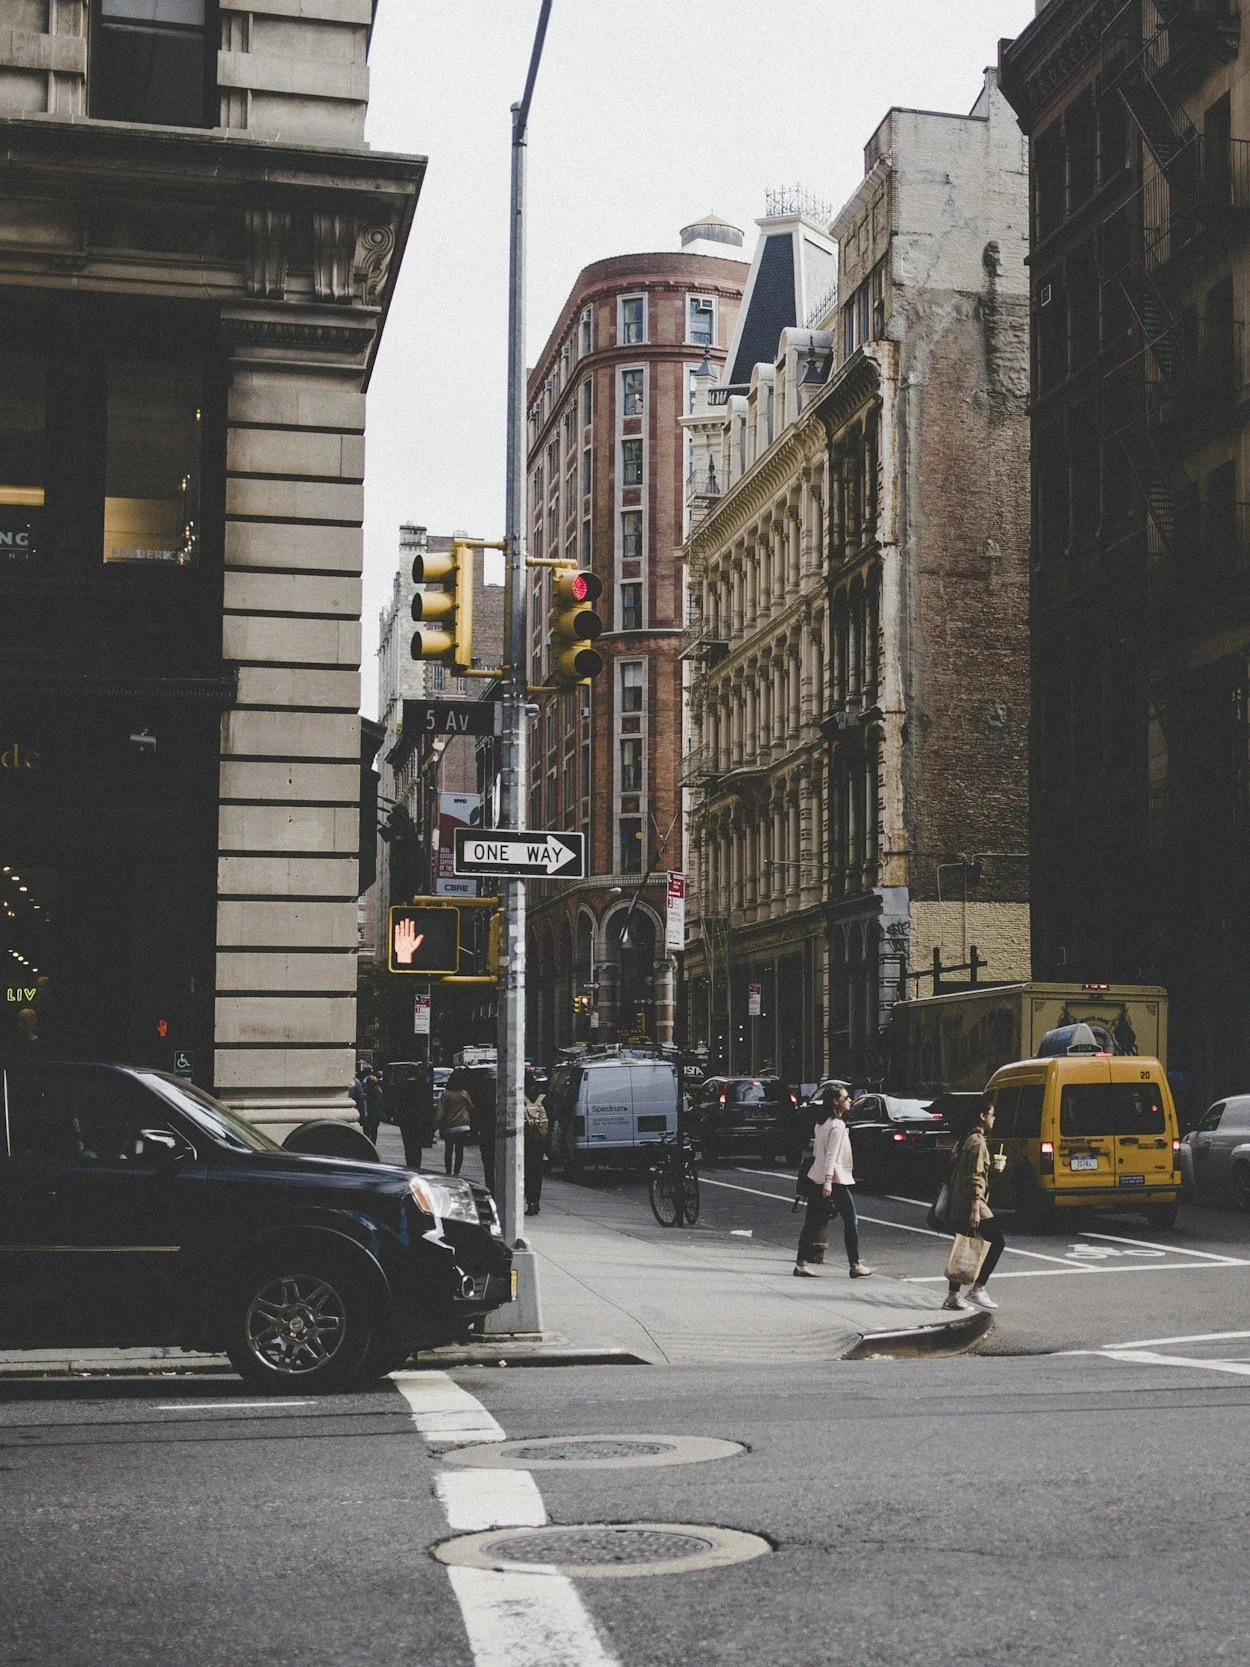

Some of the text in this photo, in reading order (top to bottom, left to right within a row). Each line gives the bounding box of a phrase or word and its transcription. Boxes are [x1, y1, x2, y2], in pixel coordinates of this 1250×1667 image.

[426, 710, 469, 730] 5 Av
[474, 843, 563, 863] ONE WAY
[1140, 1071, 1150, 1079] 20
[592, 1105, 625, 1113] Spectrum
